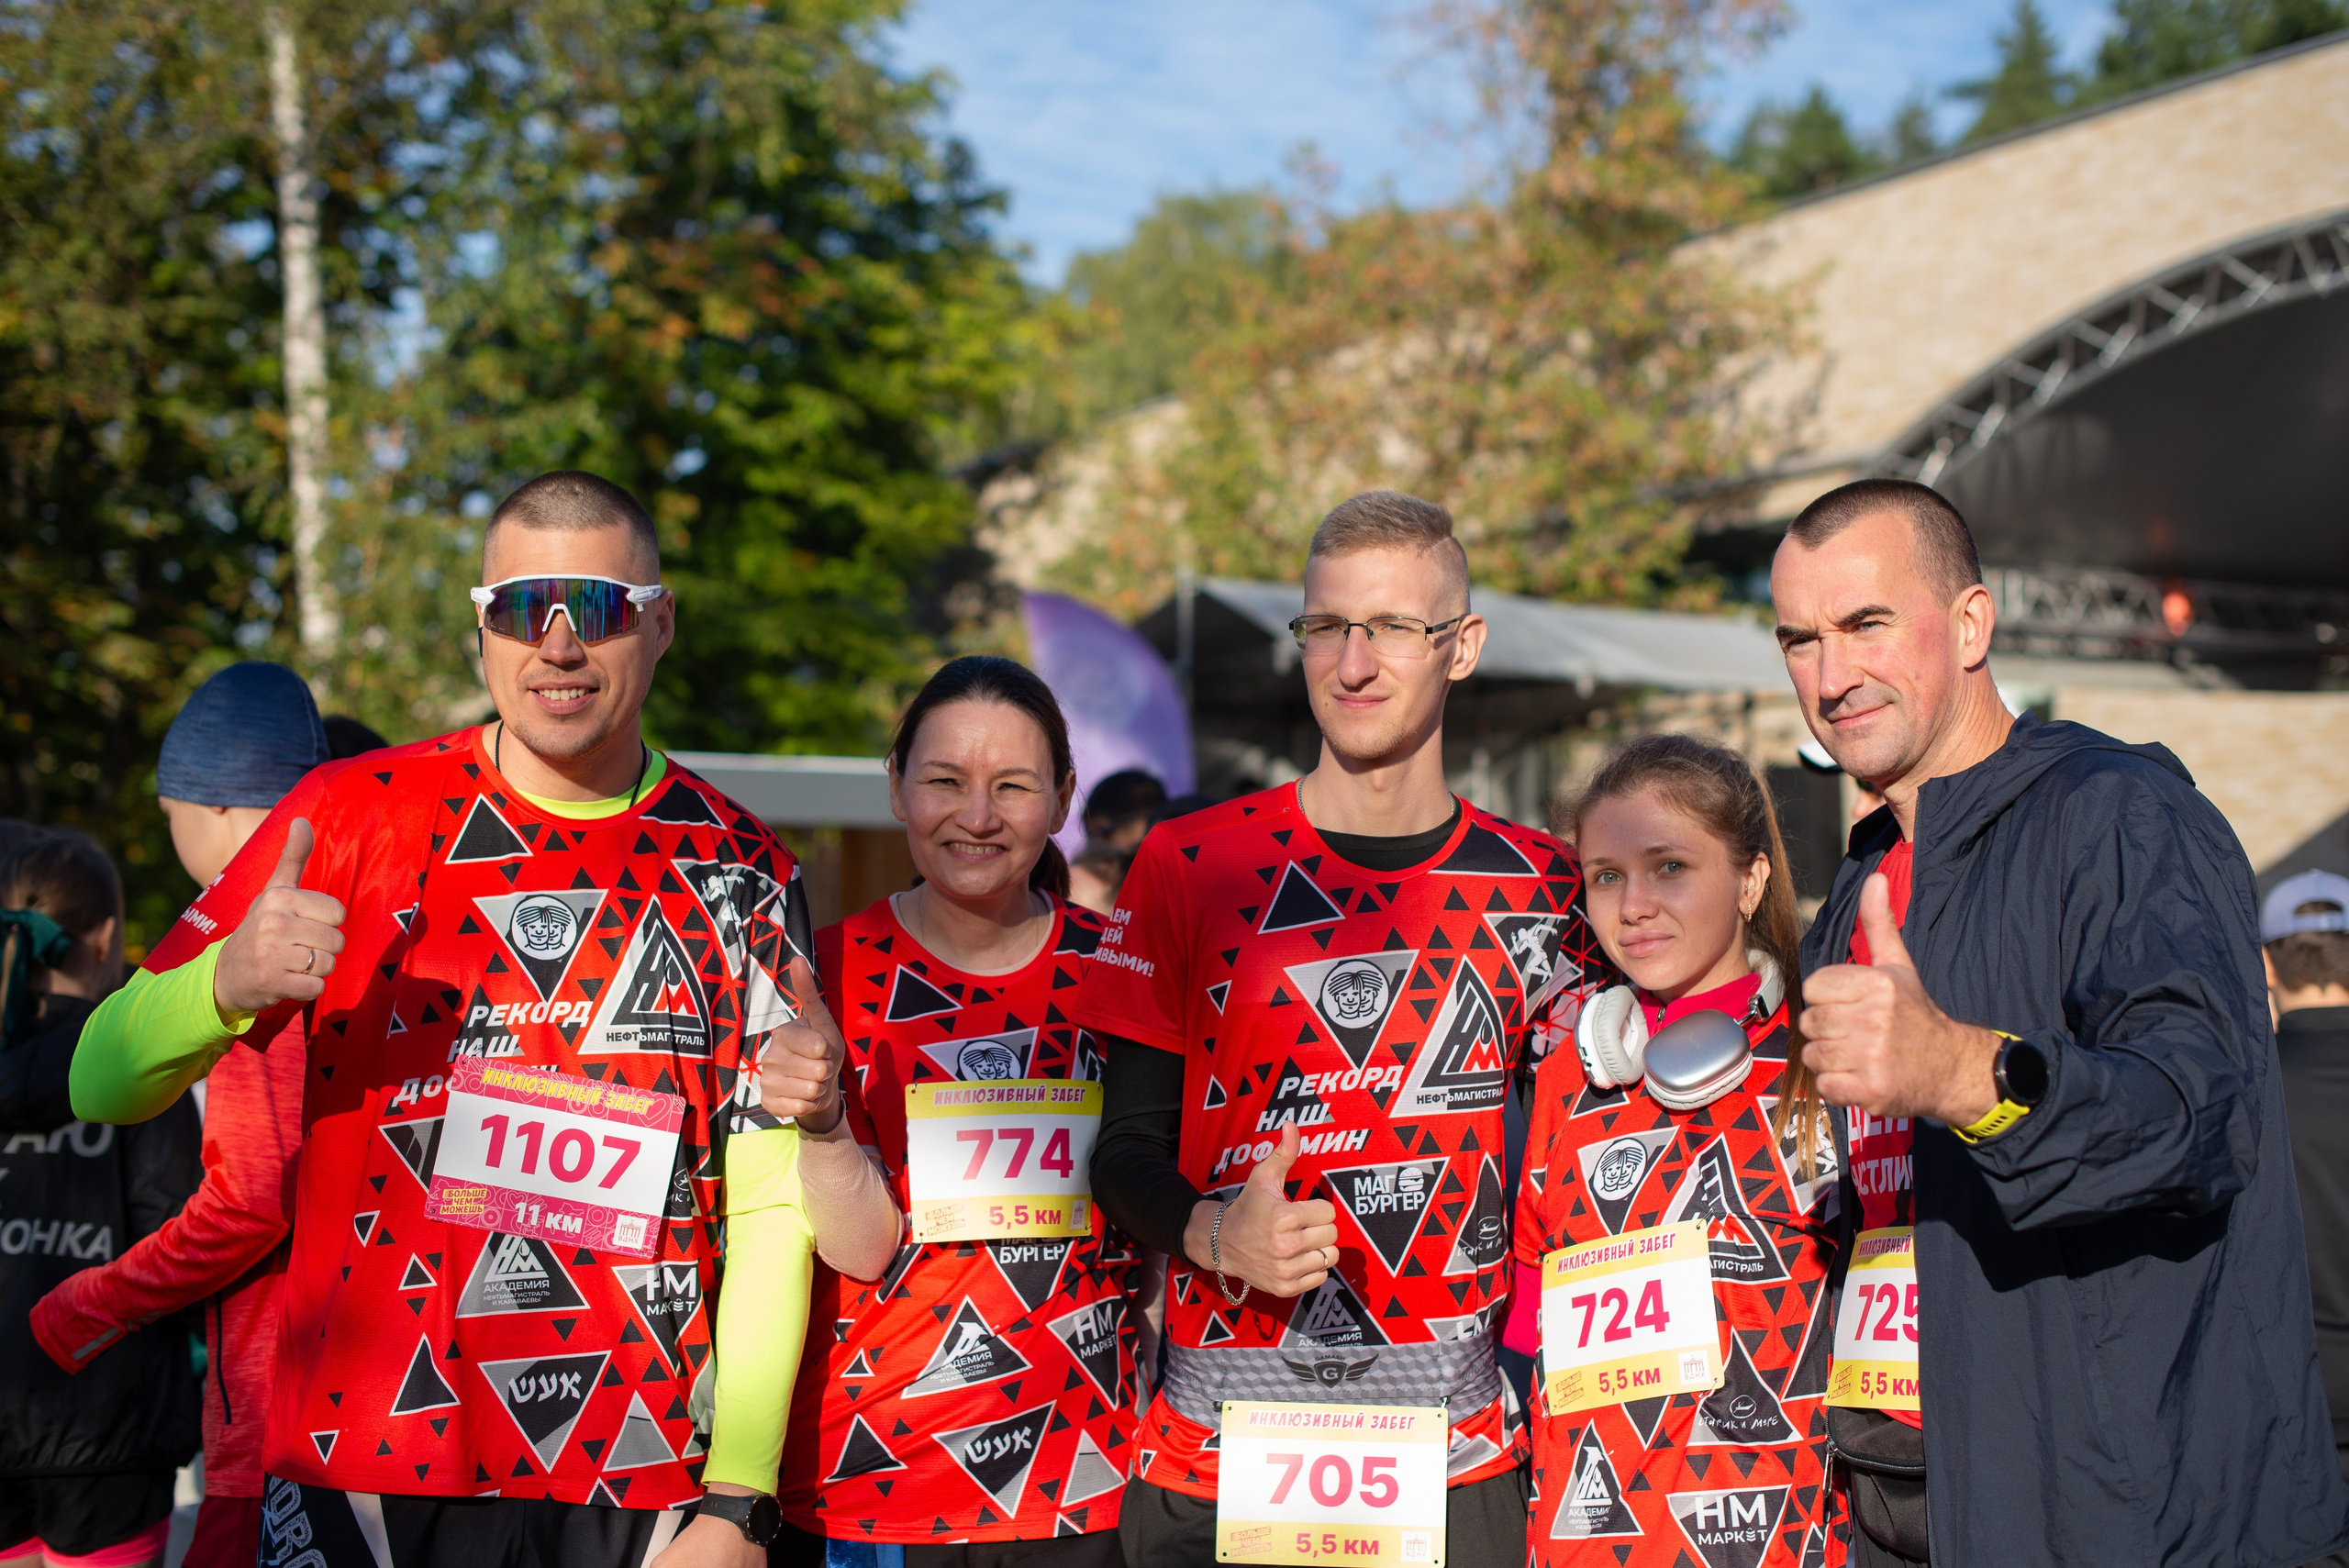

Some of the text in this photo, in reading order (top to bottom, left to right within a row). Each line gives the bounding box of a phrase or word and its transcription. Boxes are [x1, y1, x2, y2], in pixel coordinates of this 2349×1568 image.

[468, 1001, 594, 1029] РЕКОРД
[446, 1035, 520, 1063] НАШ
[391, 1074, 453, 1107] ДО
[482, 1068, 654, 1115] ИНКЛЮЗИВНЫЙ ЗАБЕГ
[934, 1084, 1086, 1106] ИНКЛЮЗИВНЫЙ ЗАБЕГ
[1277, 1065, 1405, 1099] РЕКОРД
[1255, 1103, 1330, 1132] НАШ
[480, 1114, 643, 1190] 1107
[956, 1128, 1074, 1180] 774
[1213, 1129, 1369, 1174] ДОФМИН
[448, 1189, 486, 1197] БОЛЬШЕ
[1354, 1175, 1395, 1195] МАГ
[440, 1205, 484, 1213] МОЖЕШЬ
[453, 1197, 474, 1206] ЧЕМ
[515, 1202, 540, 1226] 11
[1355, 1191, 1425, 1215] БУРГЕР
[989, 1206, 1029, 1229] 5,5
[0, 1217, 113, 1262] ОНКА
[618, 1235, 640, 1244] ВДНХ
[1557, 1232, 1676, 1274] ИНКЛЮЗИВНЫЙ ЗАБЕГ
[484, 1280, 550, 1293] АКАДЕМИЯ
[484, 1291, 551, 1301] НЕФТЬМАГИСТРАЛЬ
[1074, 1303, 1114, 1345] НМ
[1571, 1279, 1670, 1349] 724
[1854, 1284, 1919, 1342] 725
[1298, 1332, 1363, 1347] АКАДЕМИЯ
[1322, 1367, 1339, 1380] G
[1598, 1369, 1628, 1396] 5,5
[1861, 1372, 1887, 1399] 5,5
[1249, 1411, 1415, 1431] ИНКЛЮЗИВНЫЙ ЗАБЕГ
[1266, 1453, 1399, 1507] 705
[1695, 1494, 1767, 1529] НМ
[1296, 1533, 1338, 1559] 5,5
